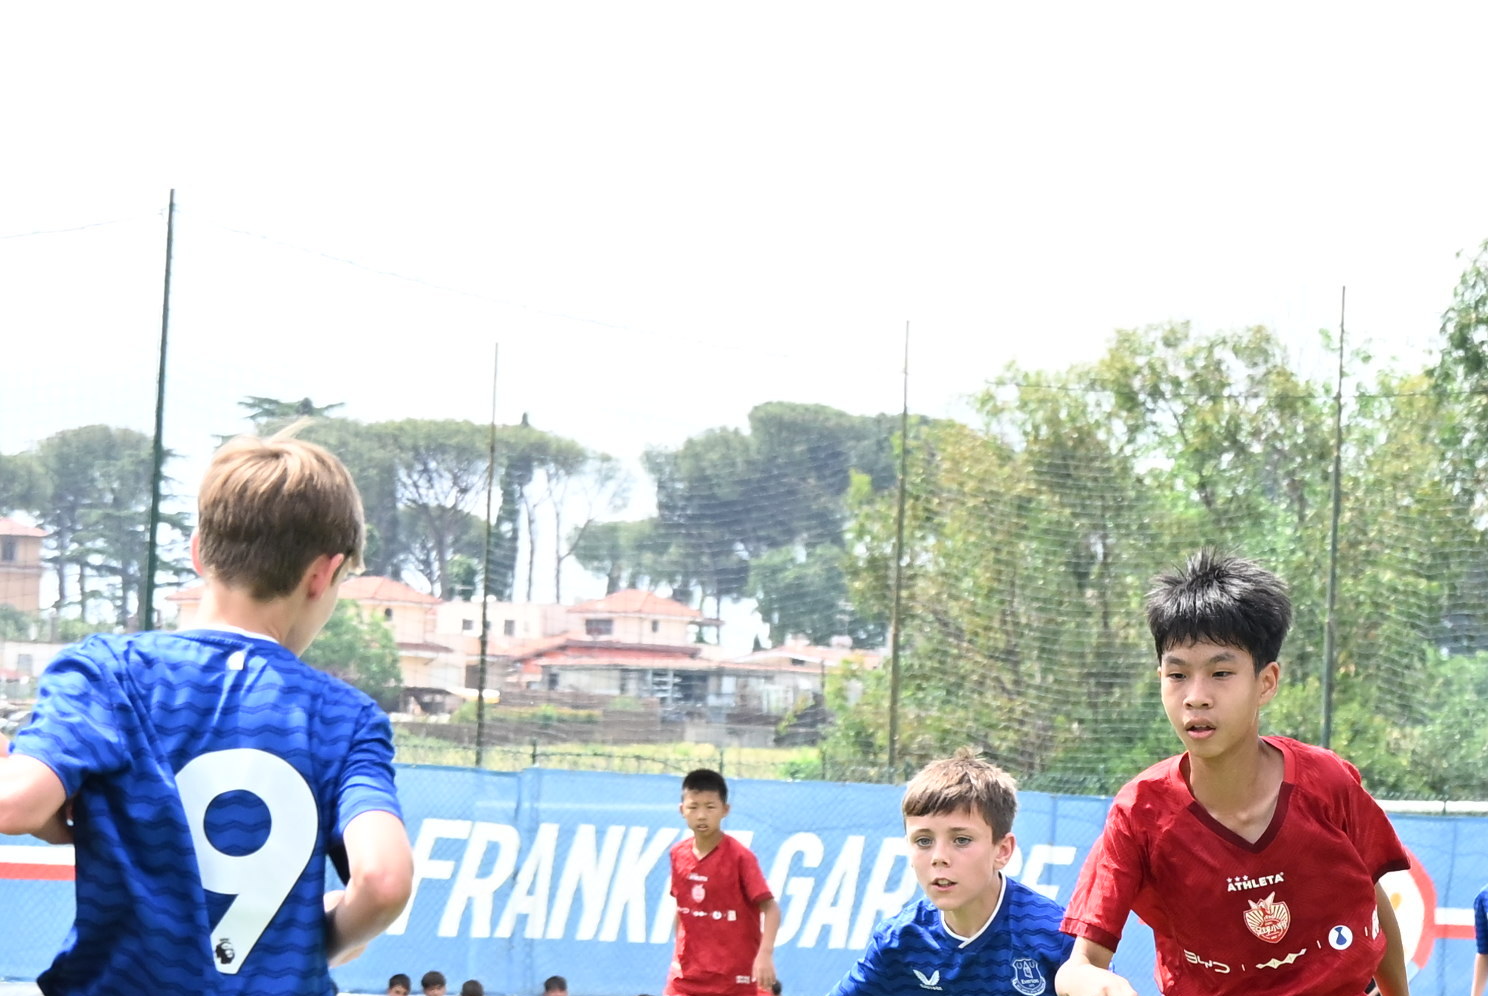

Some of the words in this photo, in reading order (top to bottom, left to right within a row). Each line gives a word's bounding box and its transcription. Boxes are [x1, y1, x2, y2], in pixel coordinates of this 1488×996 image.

[175, 748, 319, 975] 9
[1227, 873, 1284, 892] ATHLETA
[1183, 949, 1230, 974] BYD
